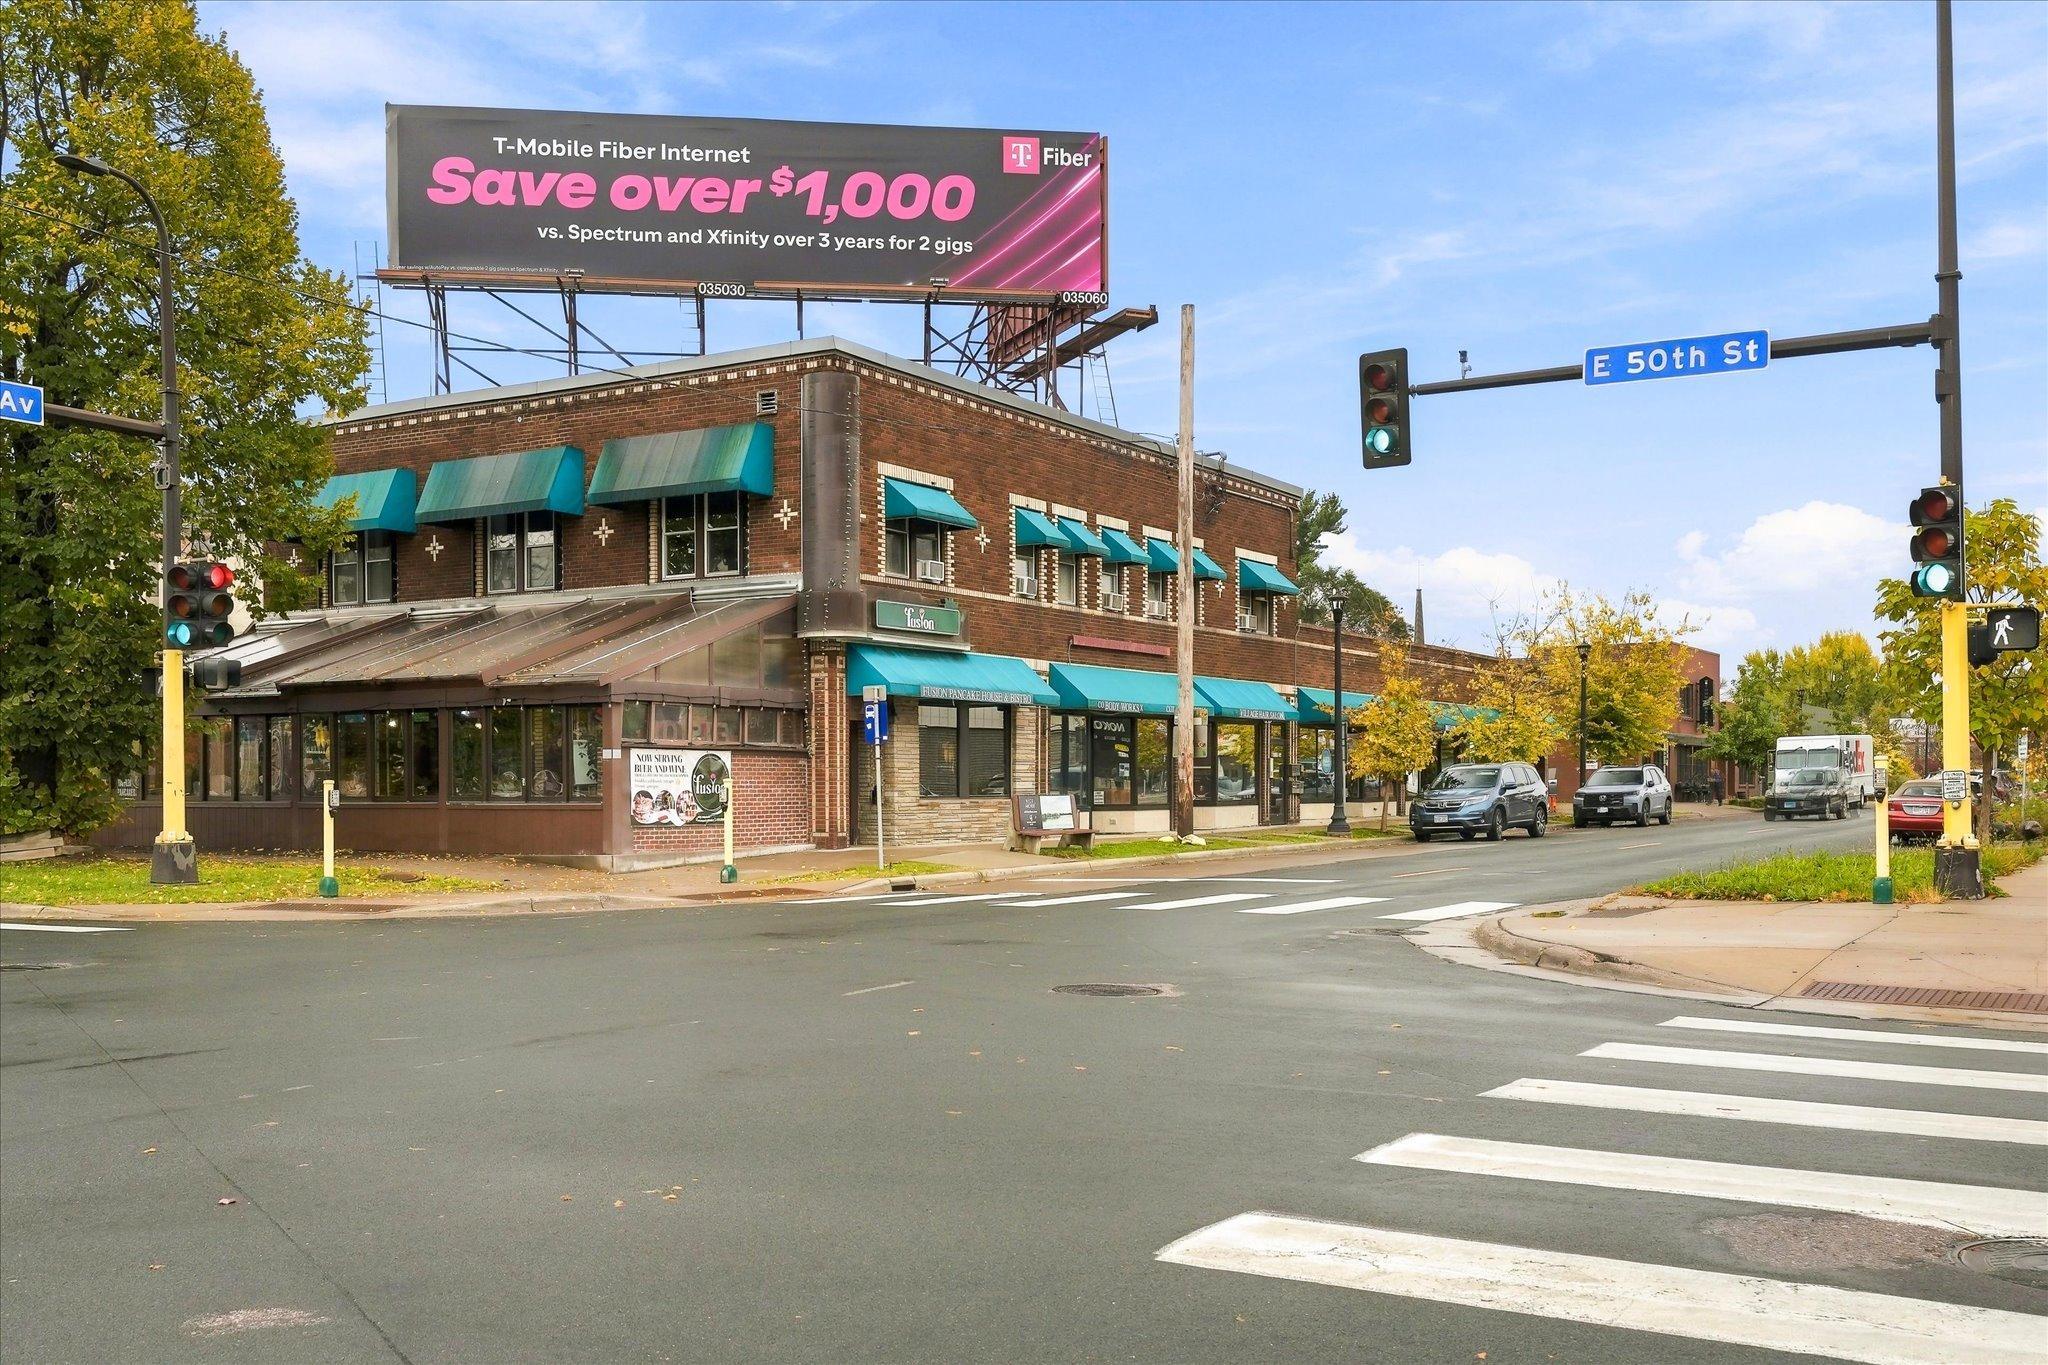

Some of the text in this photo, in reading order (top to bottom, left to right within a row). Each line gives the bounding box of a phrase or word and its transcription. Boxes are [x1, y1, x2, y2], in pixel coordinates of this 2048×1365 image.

[493, 136, 751, 164] T-Mobile Fiber Internet
[1043, 147, 1093, 168] Fiber
[427, 156, 976, 225] Save over $1,000
[537, 223, 974, 255] vs. Spectrum and Xfinity over 3 years for 2 gigs
[698, 282, 746, 297] 035030
[1062, 291, 1108, 305] 035060
[1593, 338, 1759, 378] E 50th St
[0, 390, 35, 414] Av
[904, 607, 935, 630] fusion
[922, 686, 1032, 704] FUSION PANCAKE HOUSE & BISTRO
[636, 753, 683, 764] NOW SERVING
[654, 764, 668, 774] AND
